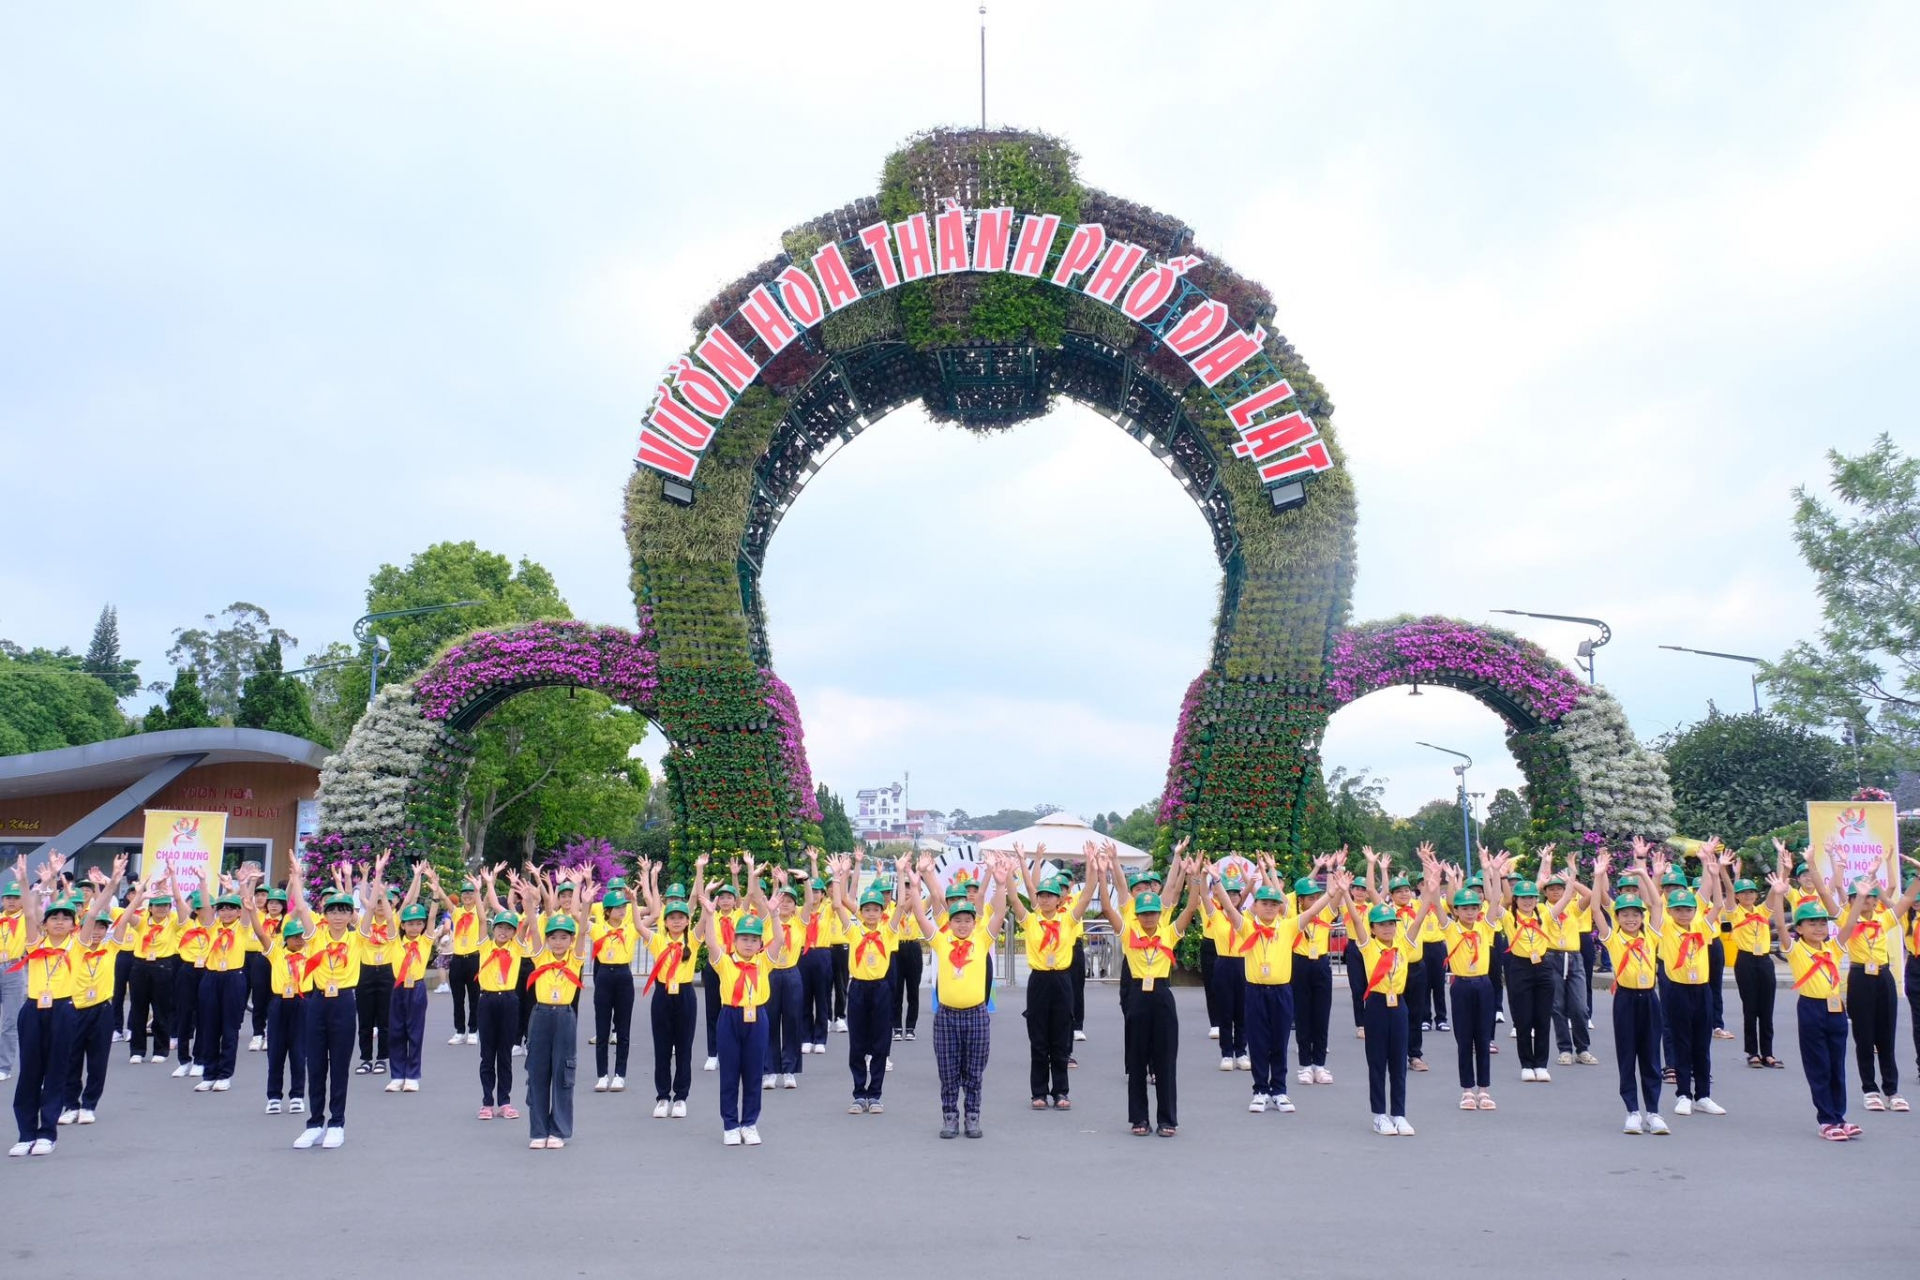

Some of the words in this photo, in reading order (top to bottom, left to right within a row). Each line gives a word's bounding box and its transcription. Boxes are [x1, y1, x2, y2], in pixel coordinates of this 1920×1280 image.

[633, 323, 762, 481] VƯỜN
[738, 241, 862, 355] HOA
[858, 197, 1060, 290] THÀNH
[1050, 222, 1204, 322] PHỐ
[1162, 298, 1268, 389] ĐÀ
[1224, 378, 1335, 484] LẠT
